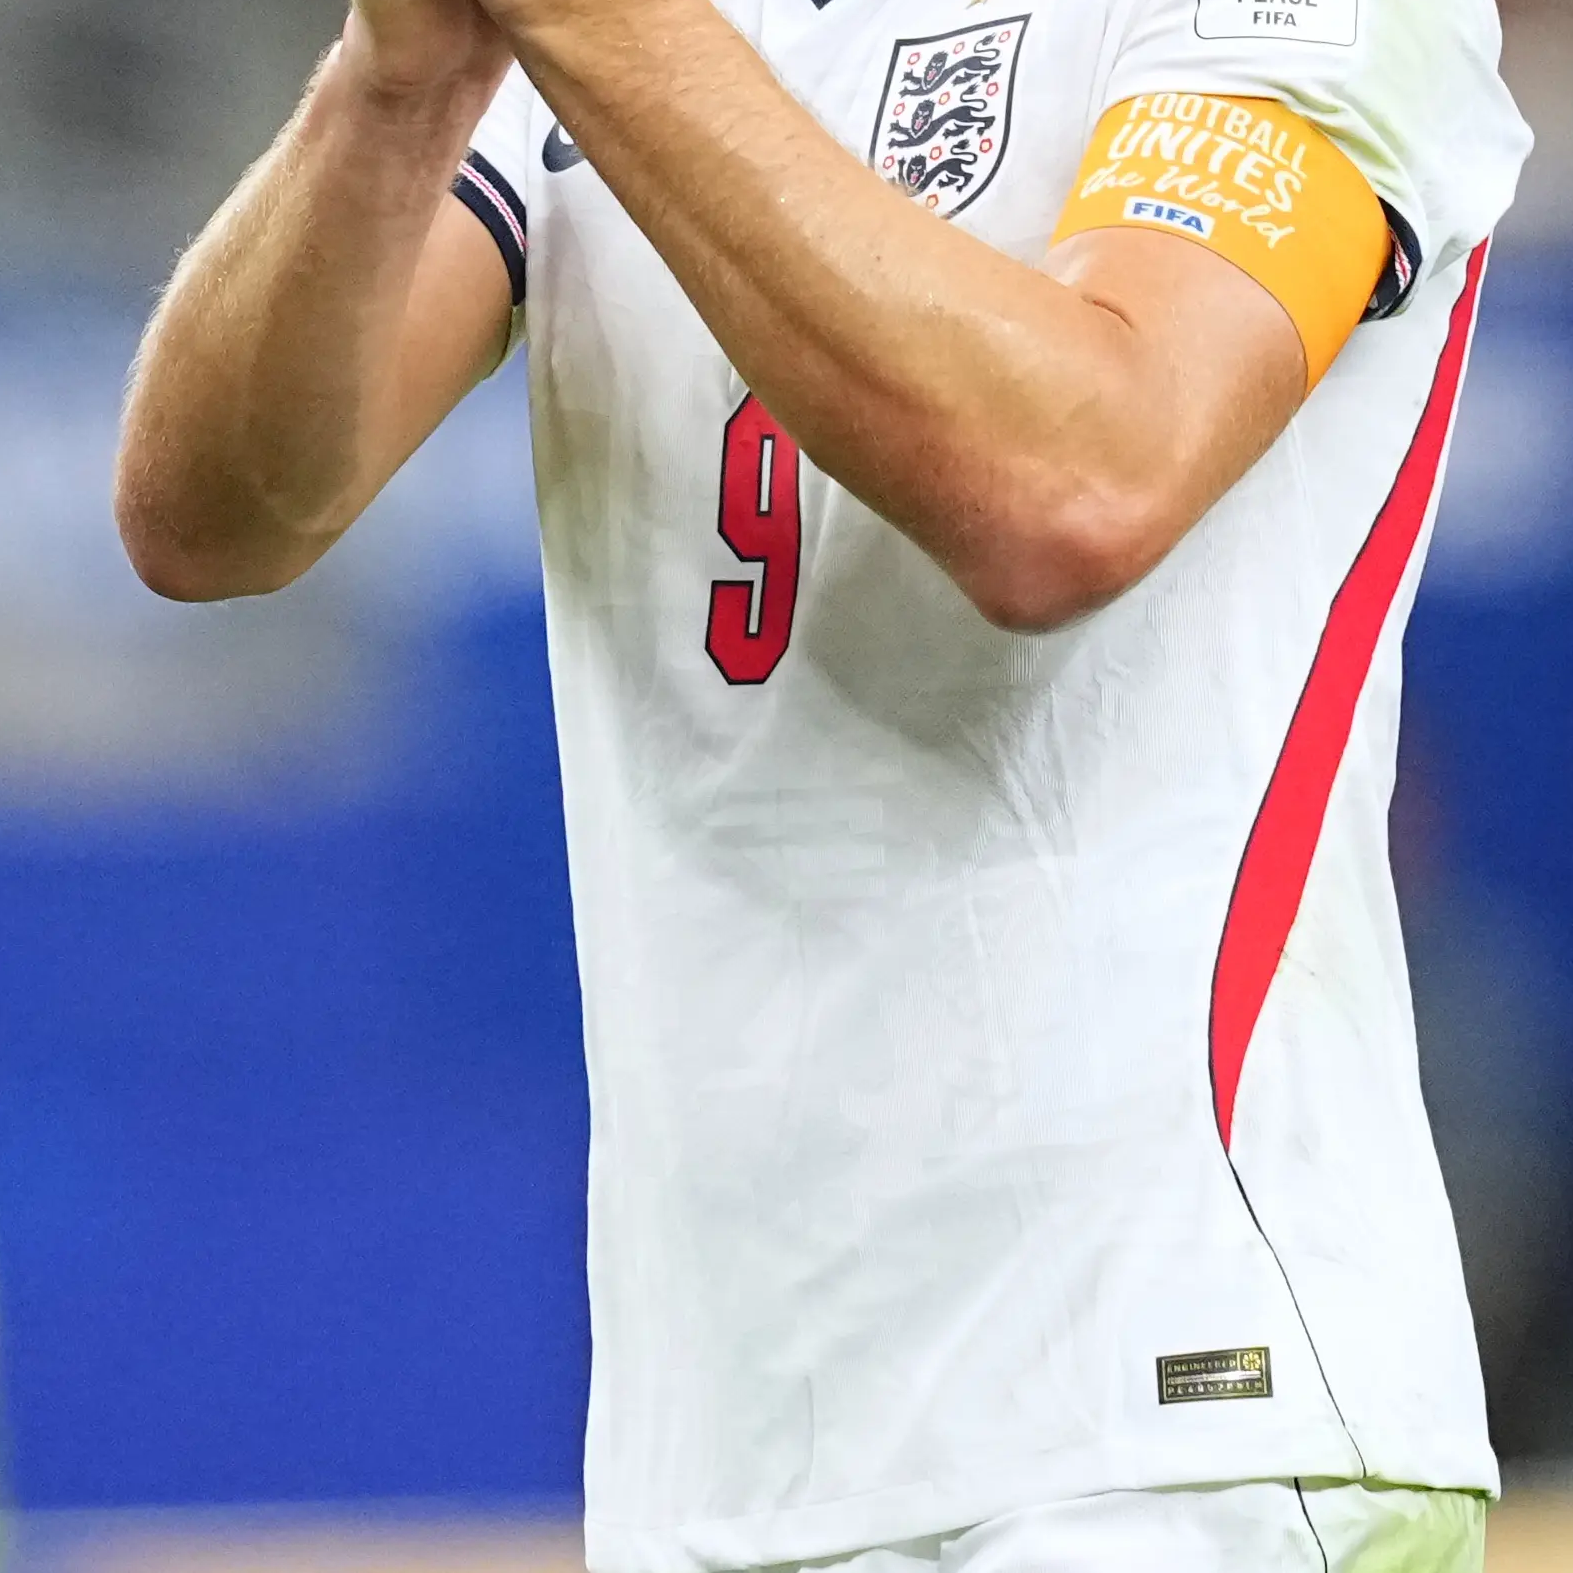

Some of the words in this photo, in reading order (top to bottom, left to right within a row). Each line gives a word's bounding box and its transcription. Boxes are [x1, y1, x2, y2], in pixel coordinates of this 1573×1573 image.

[1253, 11, 1297, 27] FIFA
[1108, 122, 1301, 212] UNITES
[1127, 93, 1307, 179] FOOTBALL
[1080, 160, 1146, 199] the
[1154, 166, 1295, 249] World
[1132, 202, 1205, 233] FIFA
[705, 390, 801, 685] 9
